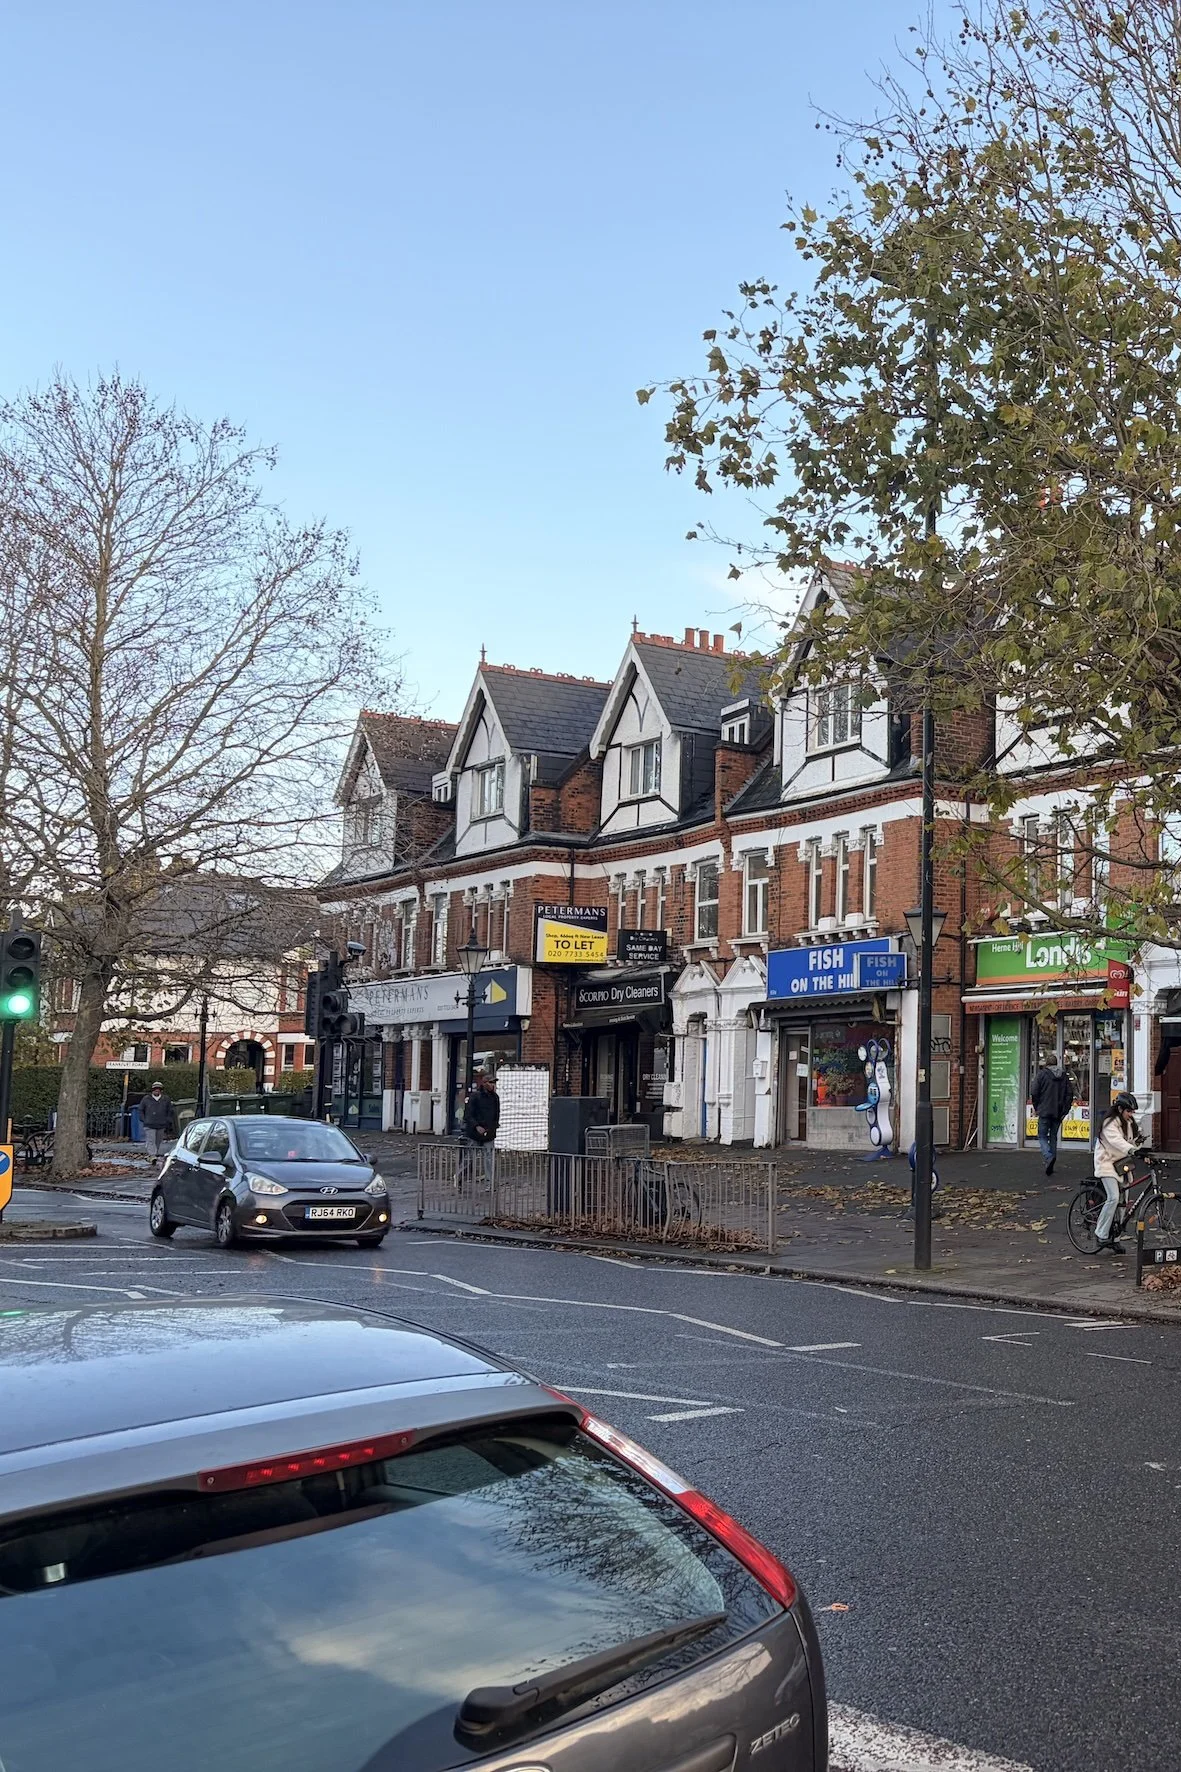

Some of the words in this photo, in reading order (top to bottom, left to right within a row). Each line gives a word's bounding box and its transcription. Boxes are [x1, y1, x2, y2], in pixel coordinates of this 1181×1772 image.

[537, 905, 606, 917] PETERMANS
[554, 940, 571, 950] TO
[574, 941, 595, 950] LET
[626, 944, 647, 952] SAME
[648, 945, 663, 953] DAY
[991, 943, 1012, 953] Herne
[1025, 937, 1092, 968] Londis
[808, 948, 844, 971] FISH
[866, 956, 897, 968] FISH
[876, 969, 889, 977] ON
[790, 977, 808, 993] ON
[813, 975, 833, 991] THE
[611, 987, 625, 1002] Dry
[625, 985, 659, 999] Cleaners
[991, 1034, 1018, 1043] Welcome
[311, 1208, 334, 1217] RJ64
[750, 1712, 801, 1755] ZETEC
